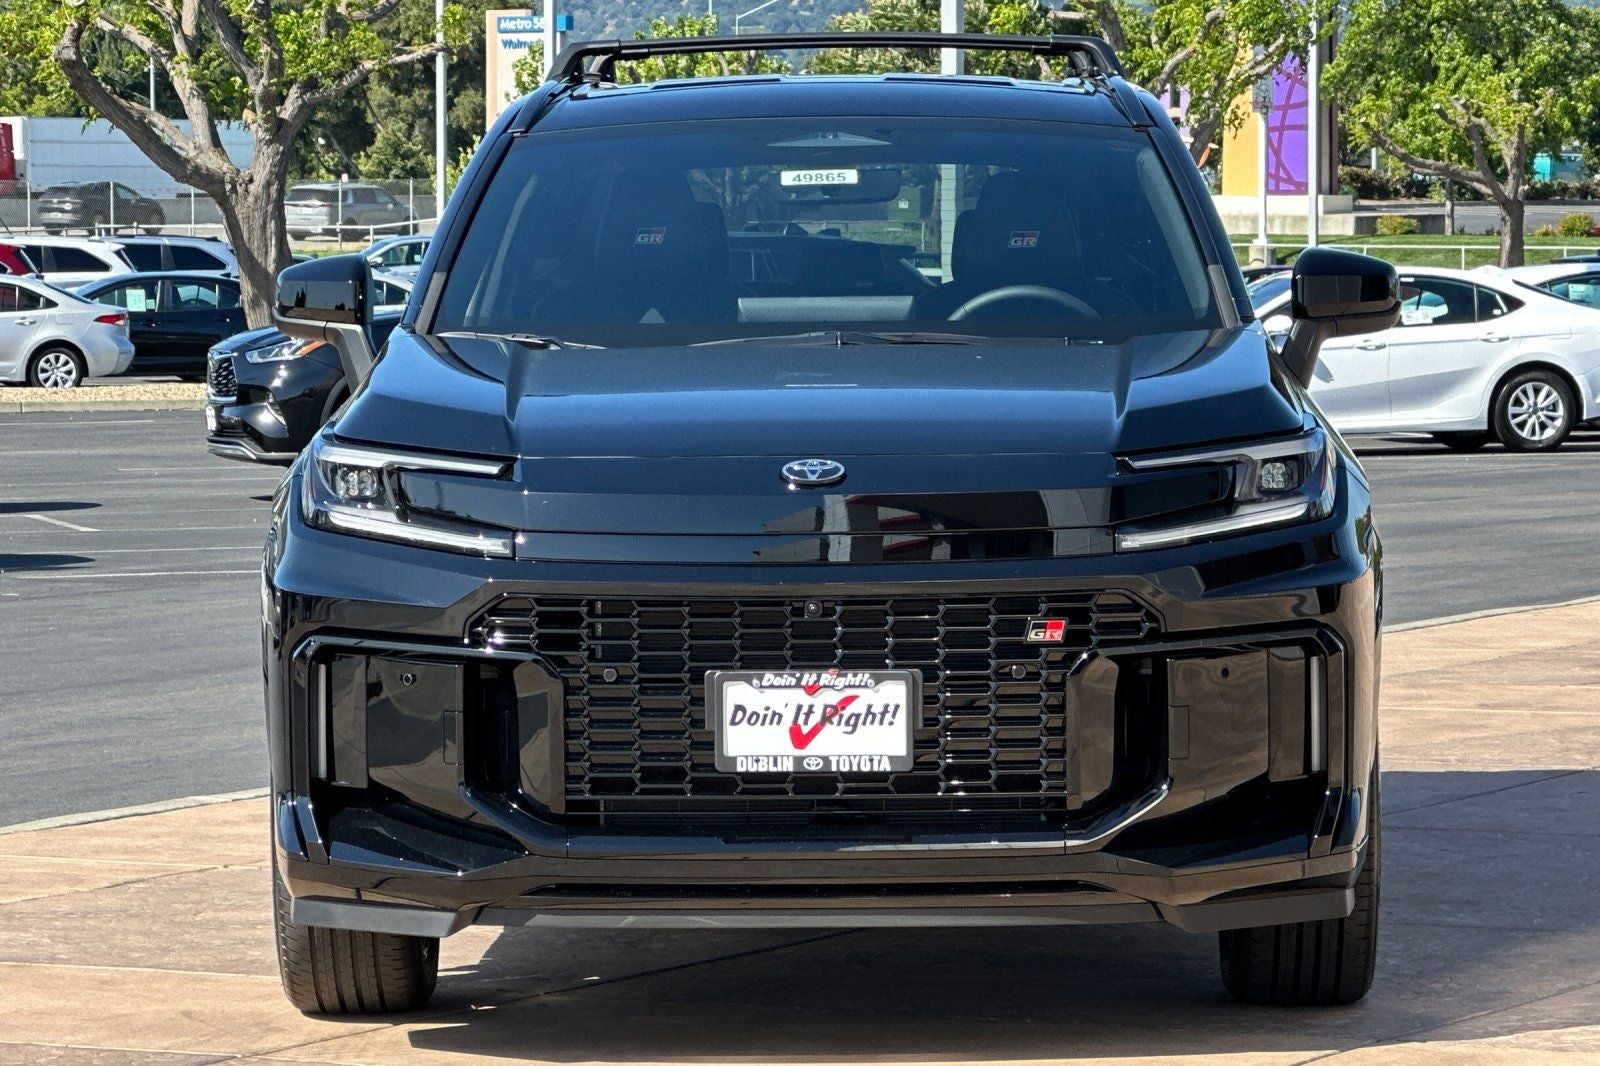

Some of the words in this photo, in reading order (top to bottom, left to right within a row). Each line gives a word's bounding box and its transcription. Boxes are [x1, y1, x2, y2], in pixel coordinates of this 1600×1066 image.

[500, 18, 532, 29] Metro
[792, 172, 847, 183] 49865
[1029, 627, 1063, 640] GR
[761, 673, 800, 687] Doin'
[801, 673, 818, 686] It
[819, 672, 870, 690] Right!
[729, 703, 788, 727] Doin'
[792, 703, 815, 726] It
[820, 703, 901, 735] Right!
[736, 755, 794, 772] DUBLIN
[829, 755, 892, 772] TOYOTA
